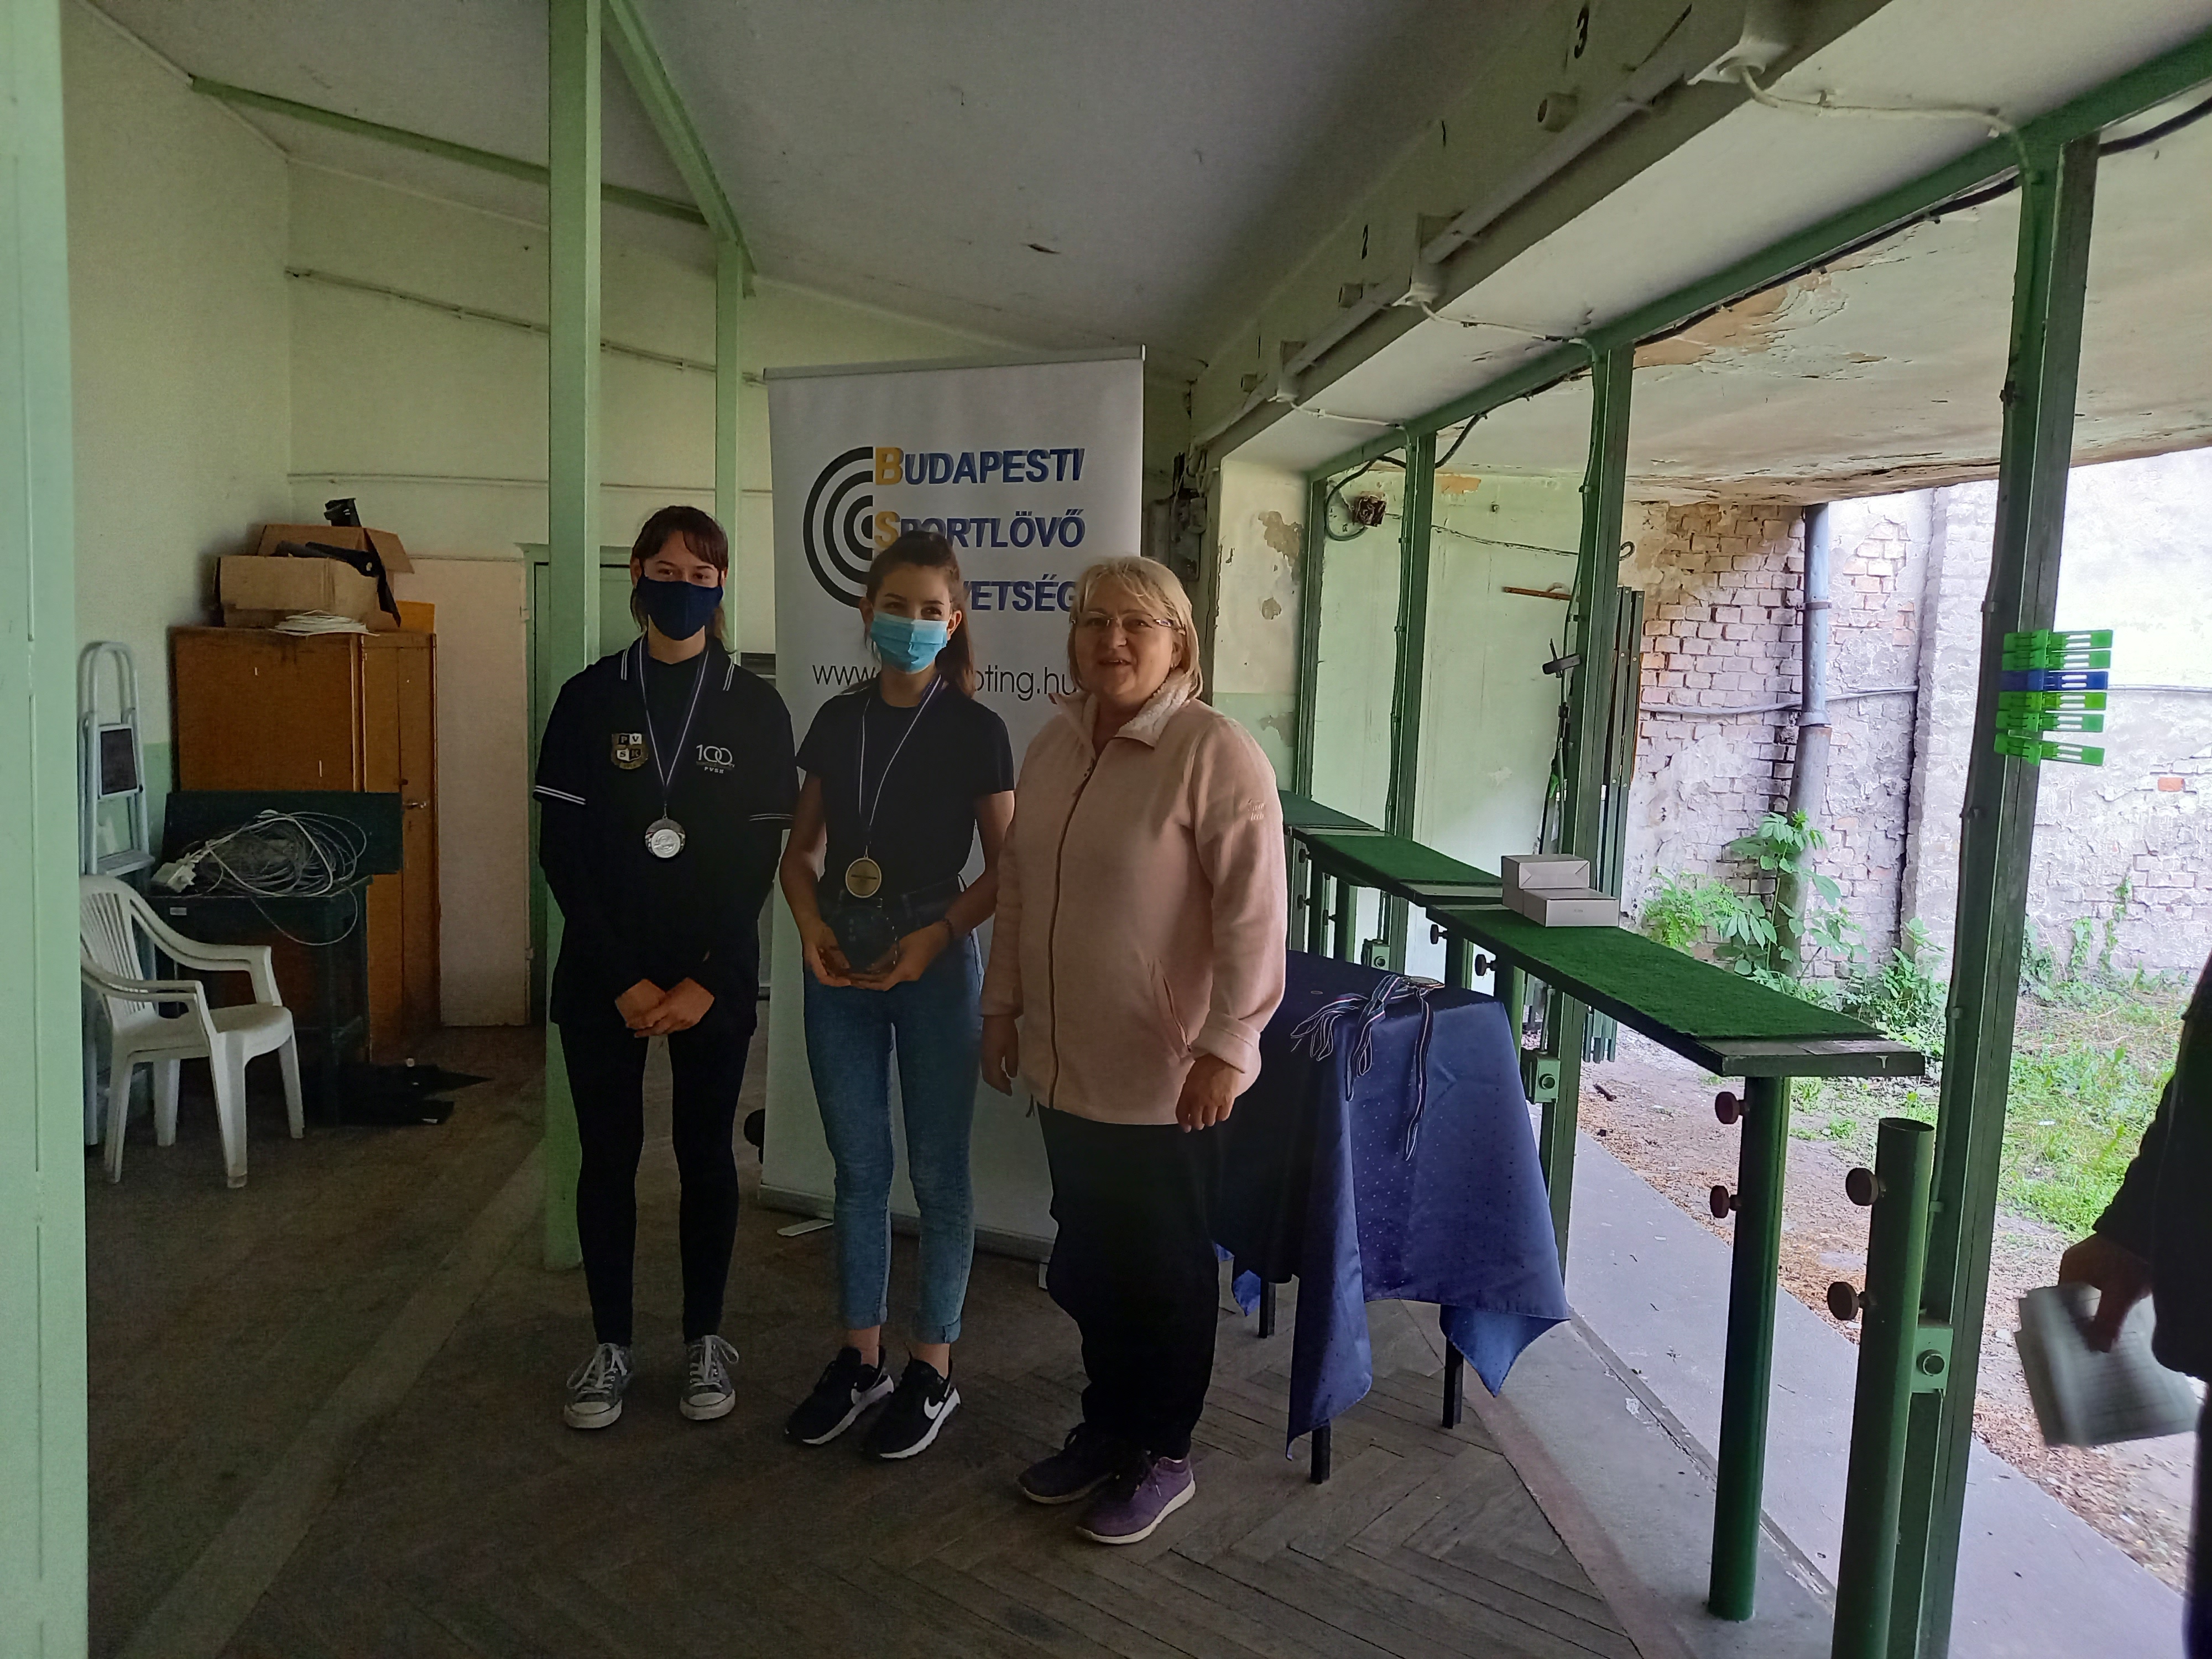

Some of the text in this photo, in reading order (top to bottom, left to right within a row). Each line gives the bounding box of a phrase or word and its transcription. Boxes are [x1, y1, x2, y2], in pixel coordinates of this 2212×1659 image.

[1574, 7, 1589, 59] 3
[1361, 225, 1368, 259] 2
[875, 447, 1085, 486] BUDAPESTI
[963, 573, 1077, 612] ETSÉG
[696, 744, 733, 765] 100
